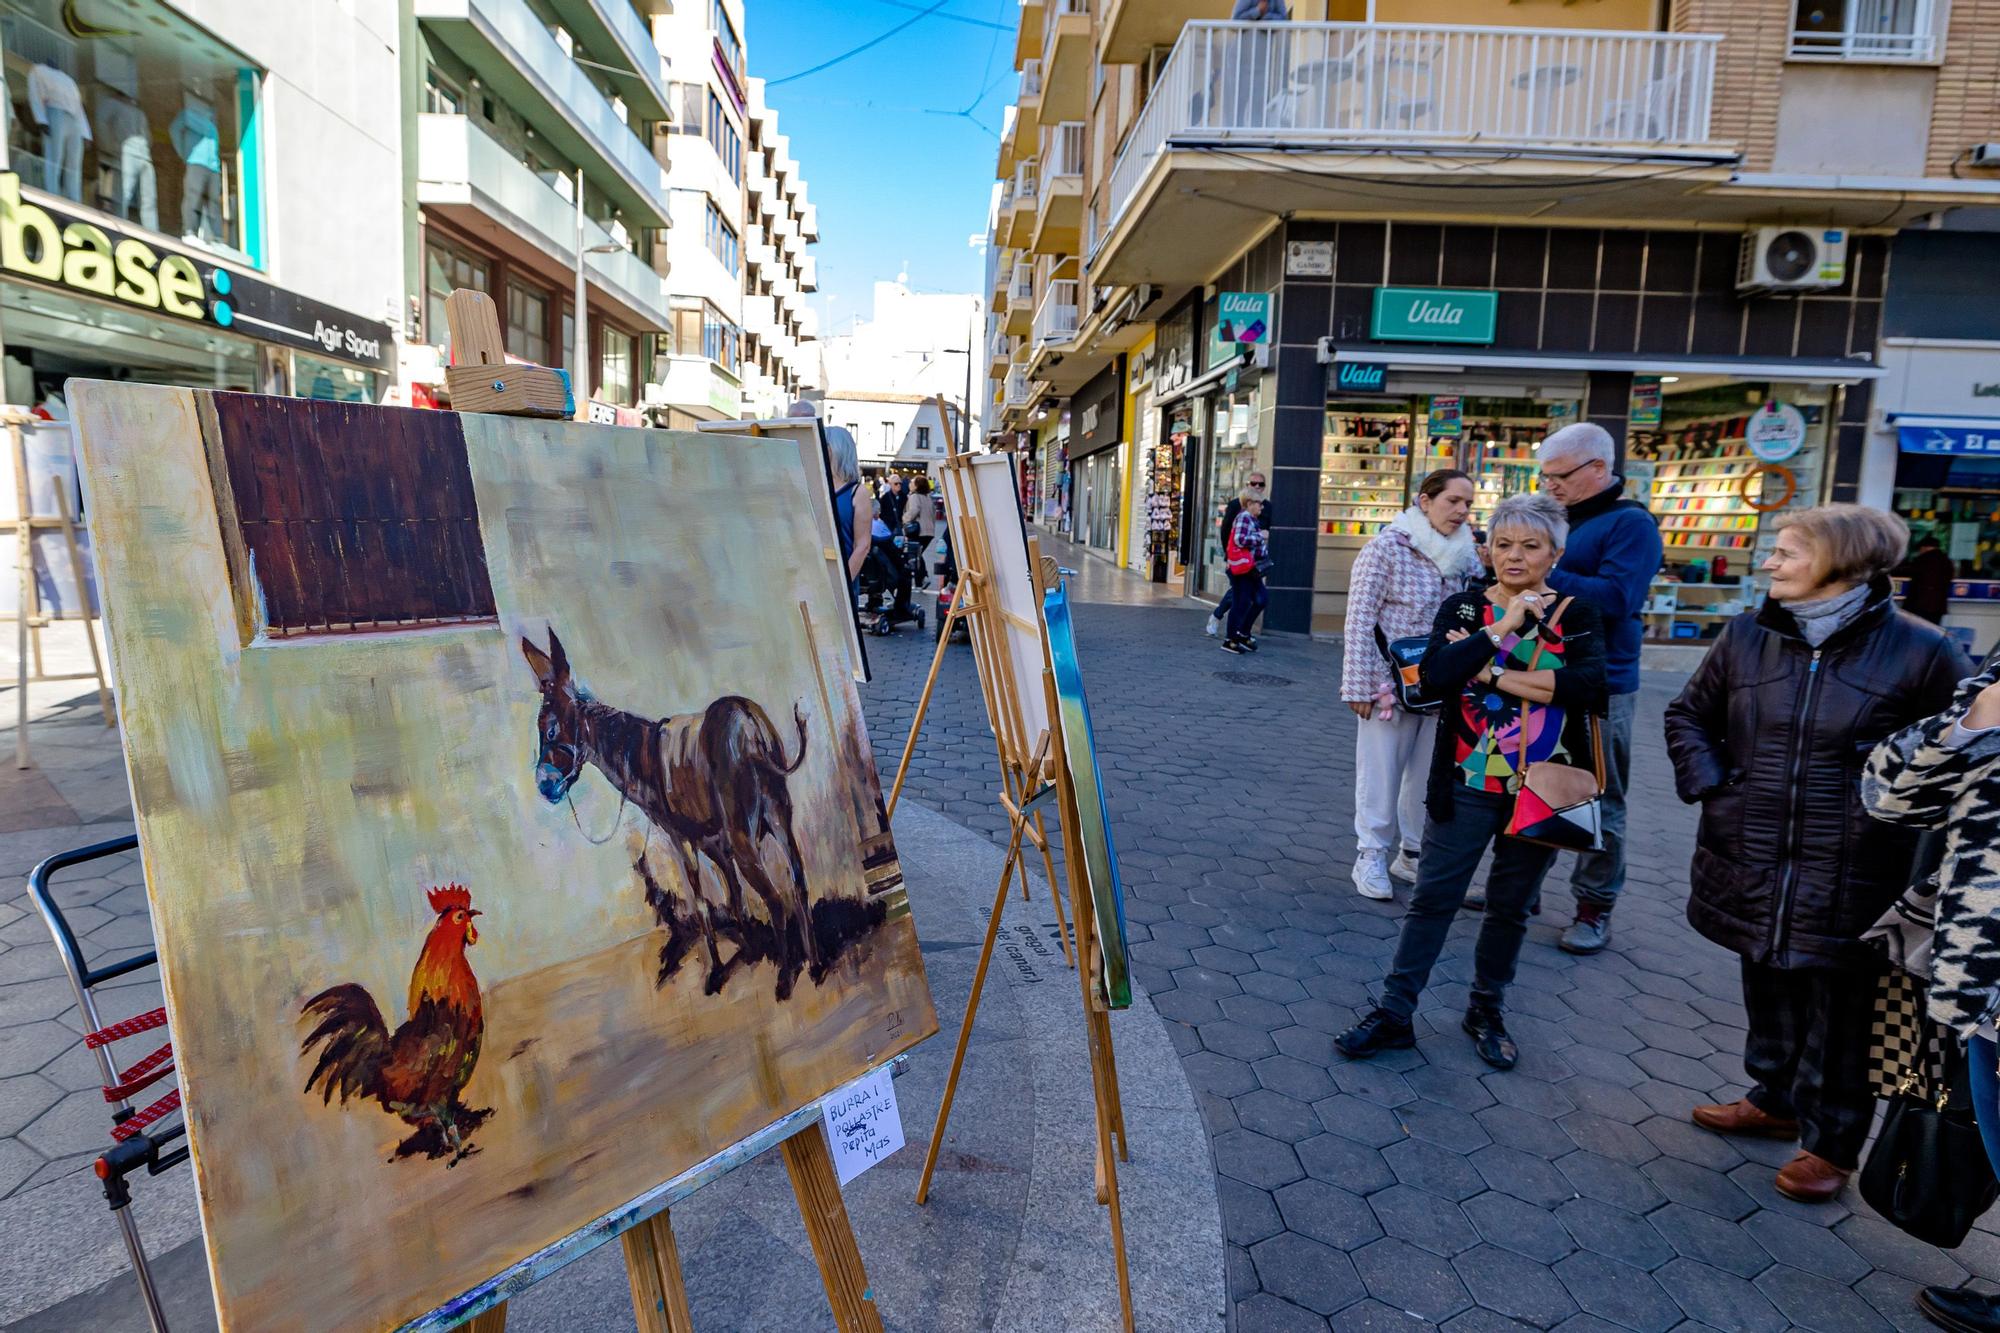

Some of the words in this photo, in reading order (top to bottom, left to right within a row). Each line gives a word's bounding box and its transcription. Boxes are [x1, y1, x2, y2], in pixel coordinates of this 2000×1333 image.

[1223, 295, 1263, 313] Uala
[1407, 300, 1464, 325] Uala
[312, 319, 345, 352] Agir
[345, 327, 381, 360] Sport
[1340, 363, 1383, 384] Uala
[1014, 925, 1055, 957] gregal
[829, 1090, 871, 1122] BURRA
